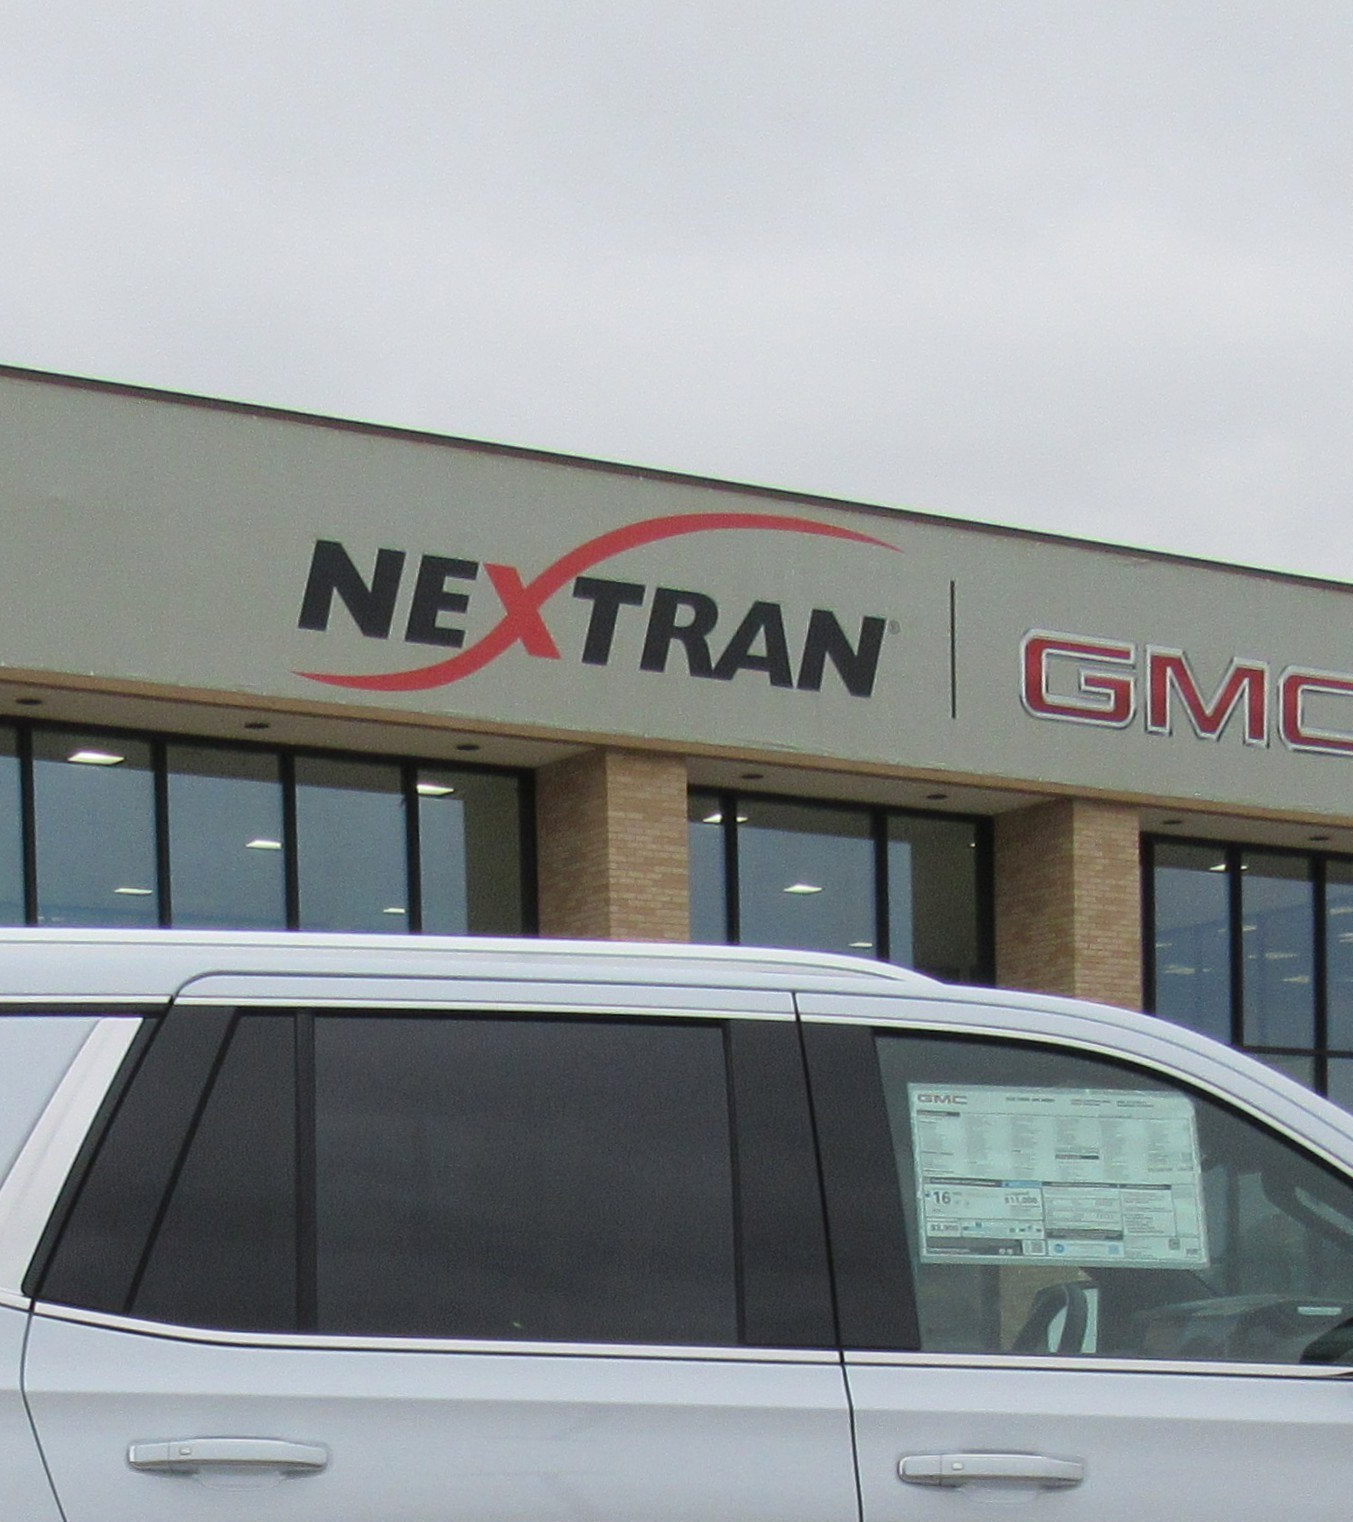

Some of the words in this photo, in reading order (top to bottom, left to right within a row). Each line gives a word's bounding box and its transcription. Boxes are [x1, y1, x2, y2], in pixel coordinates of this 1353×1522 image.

[297, 539, 888, 698] NEXTRAN
[917, 1094, 968, 1105] GMC
[933, 1190, 952, 1205] 16
